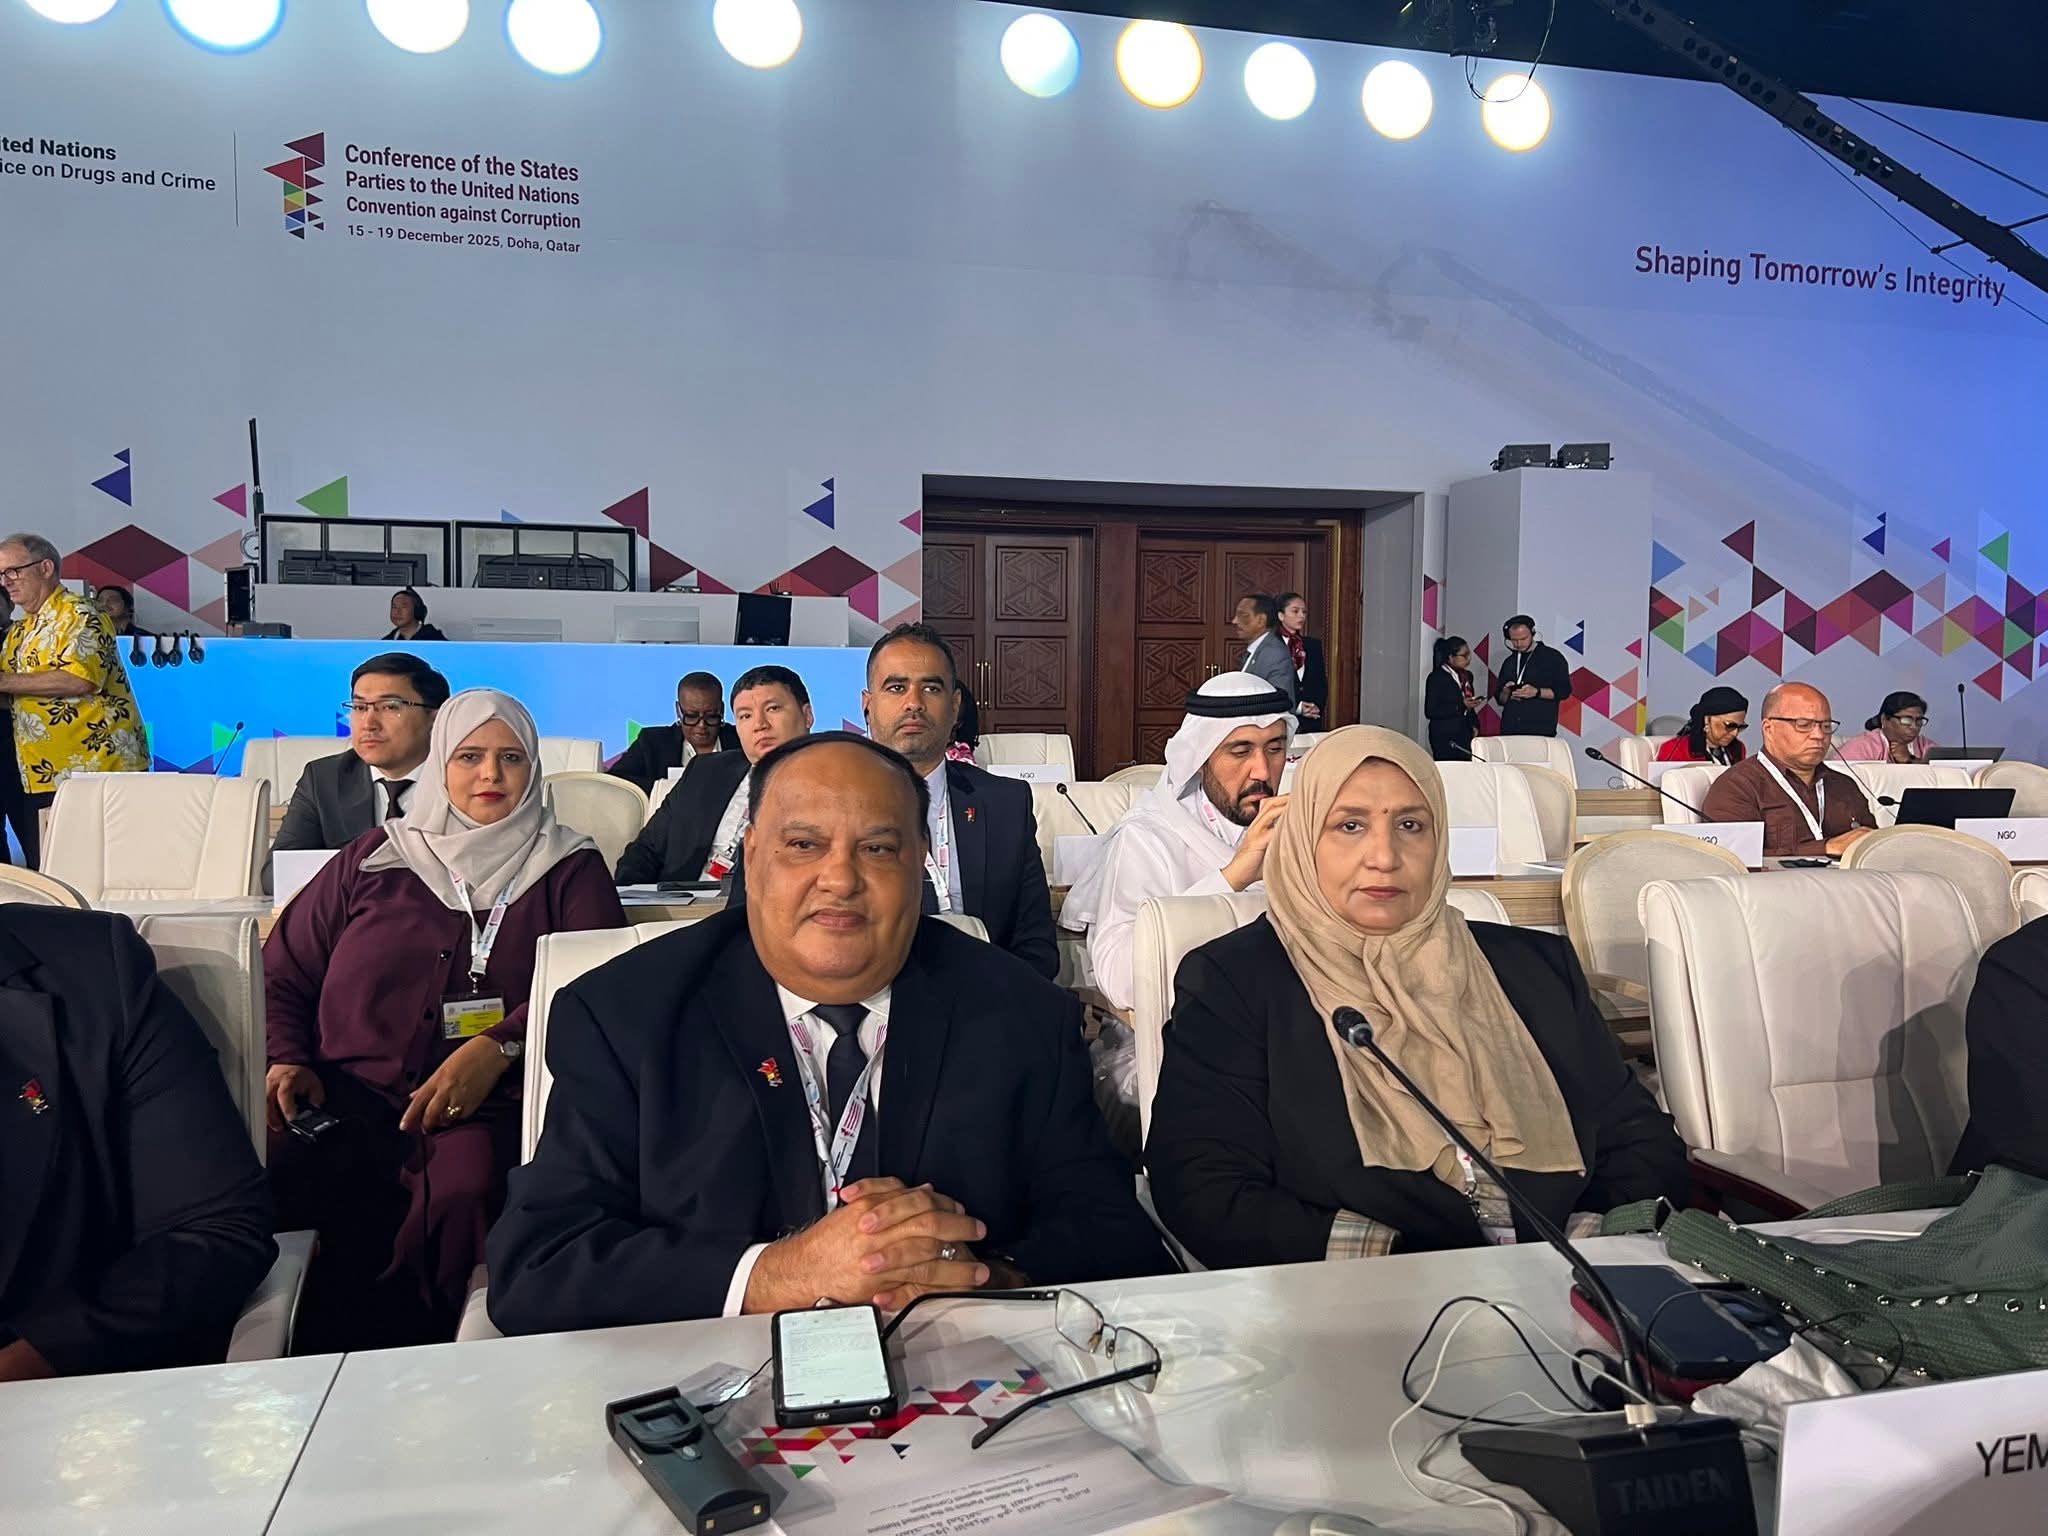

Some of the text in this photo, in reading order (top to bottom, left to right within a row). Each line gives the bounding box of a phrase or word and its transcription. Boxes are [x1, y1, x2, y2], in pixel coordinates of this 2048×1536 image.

[0, 136, 117, 160] ted Nations
[345, 144, 579, 181] Conference of the States
[32, 164, 55, 177] on
[61, 163, 116, 185] Drugs
[121, 171, 155, 185] and
[161, 172, 217, 190] Crime
[346, 171, 580, 205] Parties to the United Nations
[346, 196, 581, 230] Convention against Corruption
[348, 225, 365, 237] 15
[378, 227, 394, 239] 19
[397, 228, 464, 244] December
[467, 233, 504, 249] 2025,
[507, 236, 543, 252] Doha,
[546, 240, 581, 253] Qatar
[1635, 245, 2007, 307] Shaping Tomorrow’s Integrity
[1697, 836, 1719, 846] GO
[1997, 830, 2017, 840] NGO
[1976, 1432, 2048, 1478] YEM
[1608, 1467, 1731, 1515] TAIDEN
